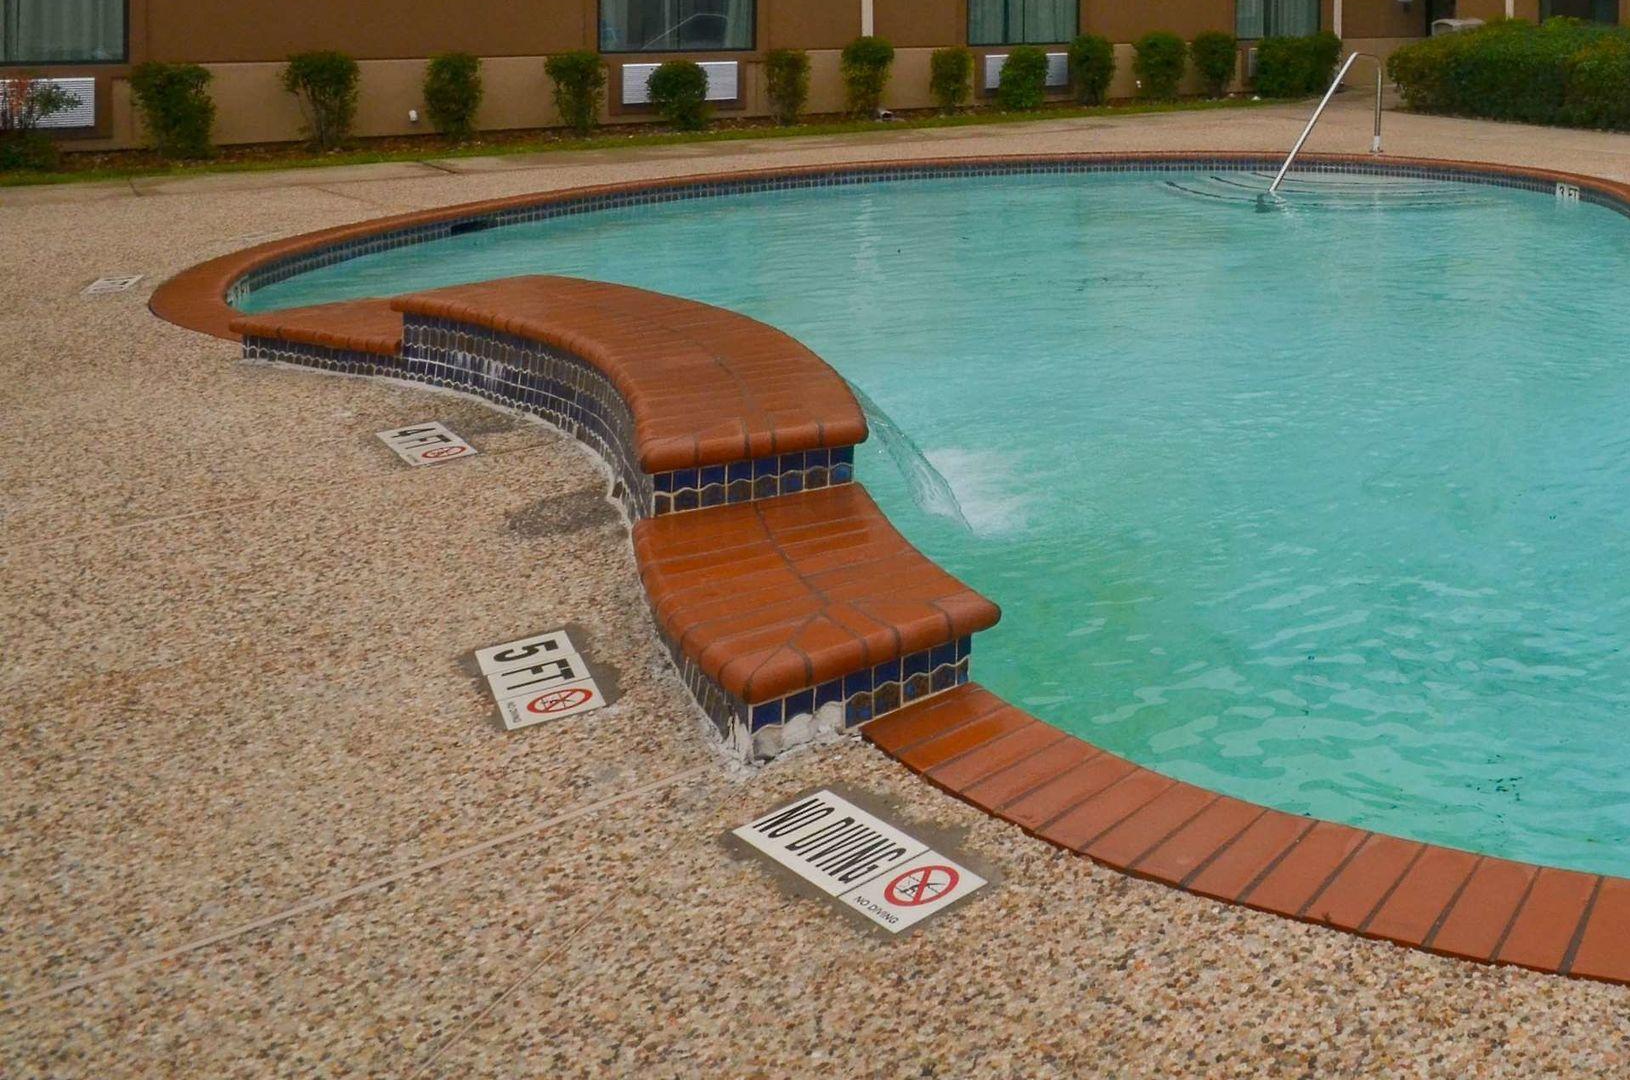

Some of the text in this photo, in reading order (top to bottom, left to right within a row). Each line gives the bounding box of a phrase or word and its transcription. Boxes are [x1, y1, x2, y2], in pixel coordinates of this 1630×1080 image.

[391, 427, 451, 450] 4 FT
[493, 639, 575, 691] 5 FT
[752, 798, 908, 884] NO DIVING
[855, 895, 899, 924] NO DIVING
